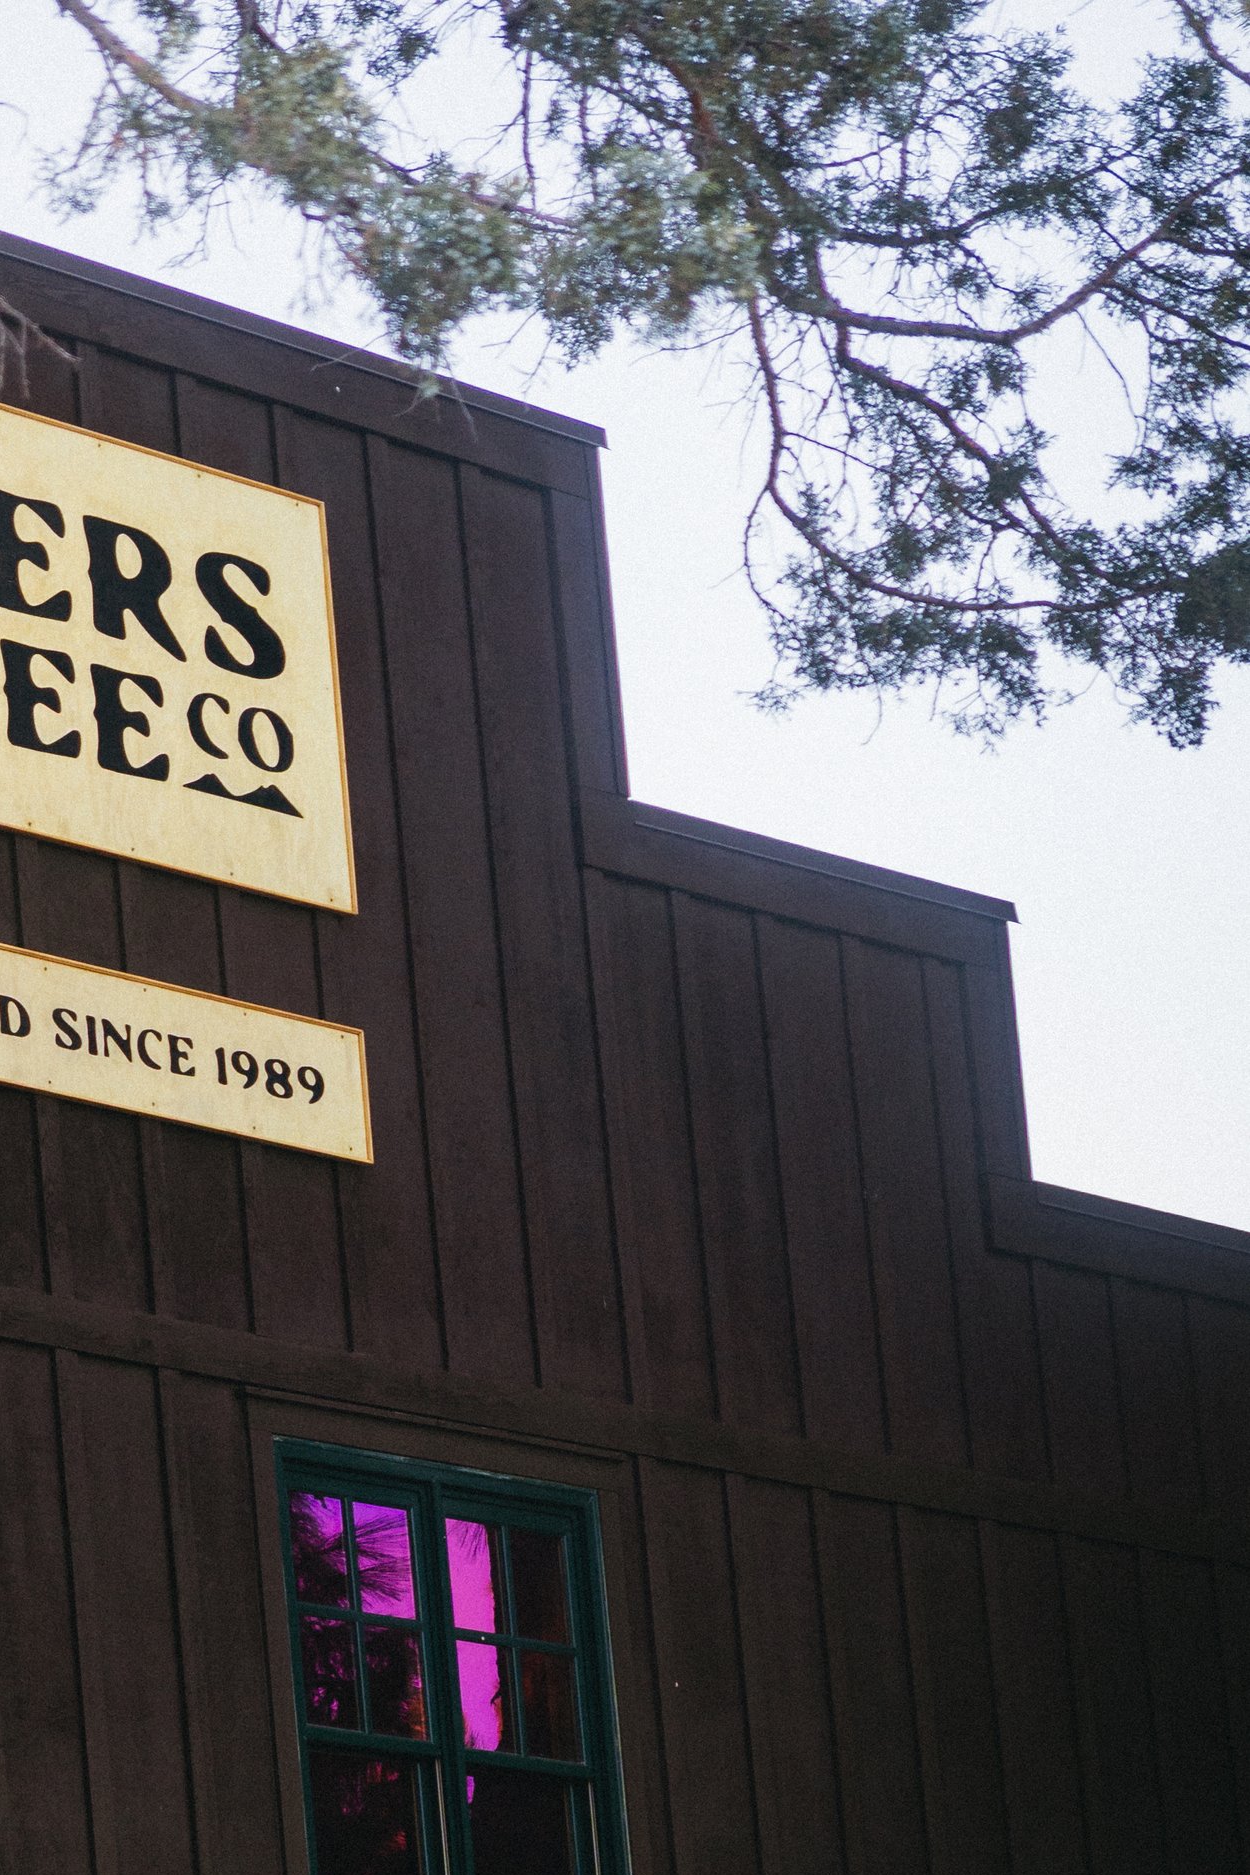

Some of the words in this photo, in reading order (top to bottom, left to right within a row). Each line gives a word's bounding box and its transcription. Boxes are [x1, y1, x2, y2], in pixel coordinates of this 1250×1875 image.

[186, 692, 294, 773] CO
[51, 1007, 196, 1077] SINCE
[214, 1046, 325, 1105] 1989
